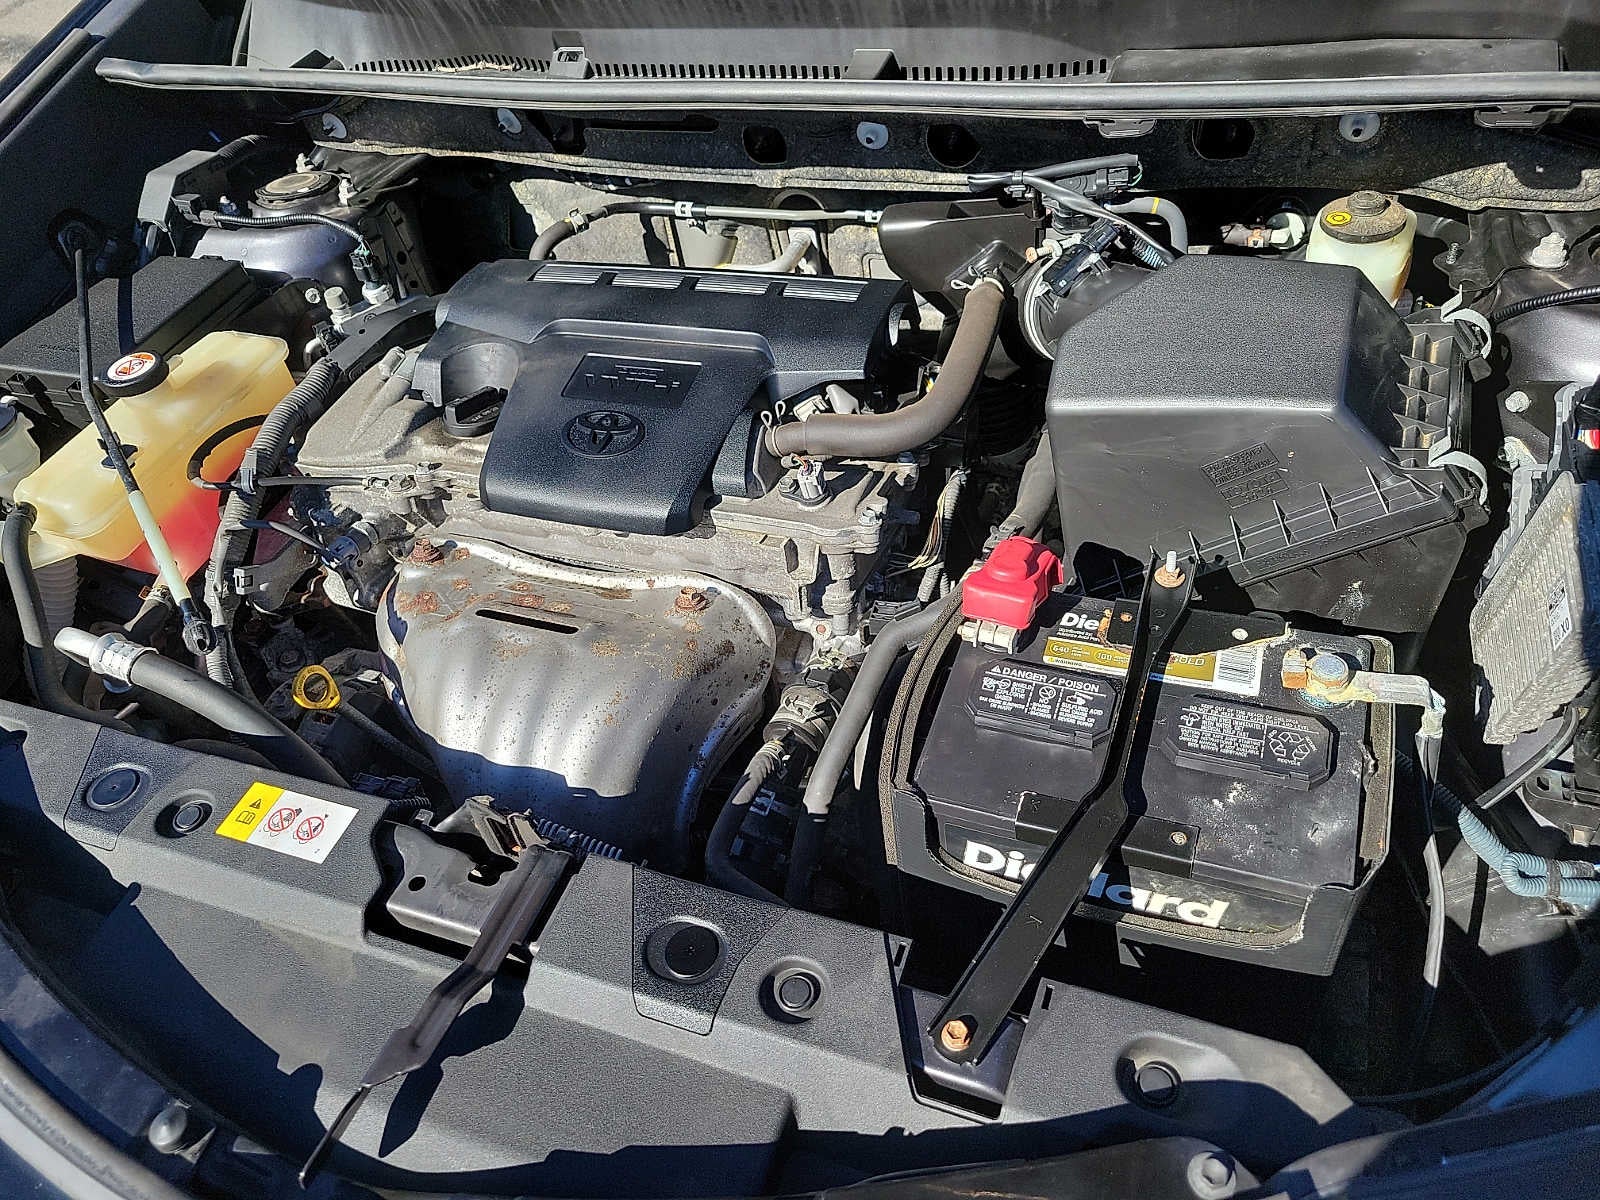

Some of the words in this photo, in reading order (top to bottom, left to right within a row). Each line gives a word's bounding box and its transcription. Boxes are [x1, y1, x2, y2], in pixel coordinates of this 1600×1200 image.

[1002, 667, 1047, 682] DANGER
[1058, 678, 1100, 692] POISON
[964, 840, 1230, 928] Diard
